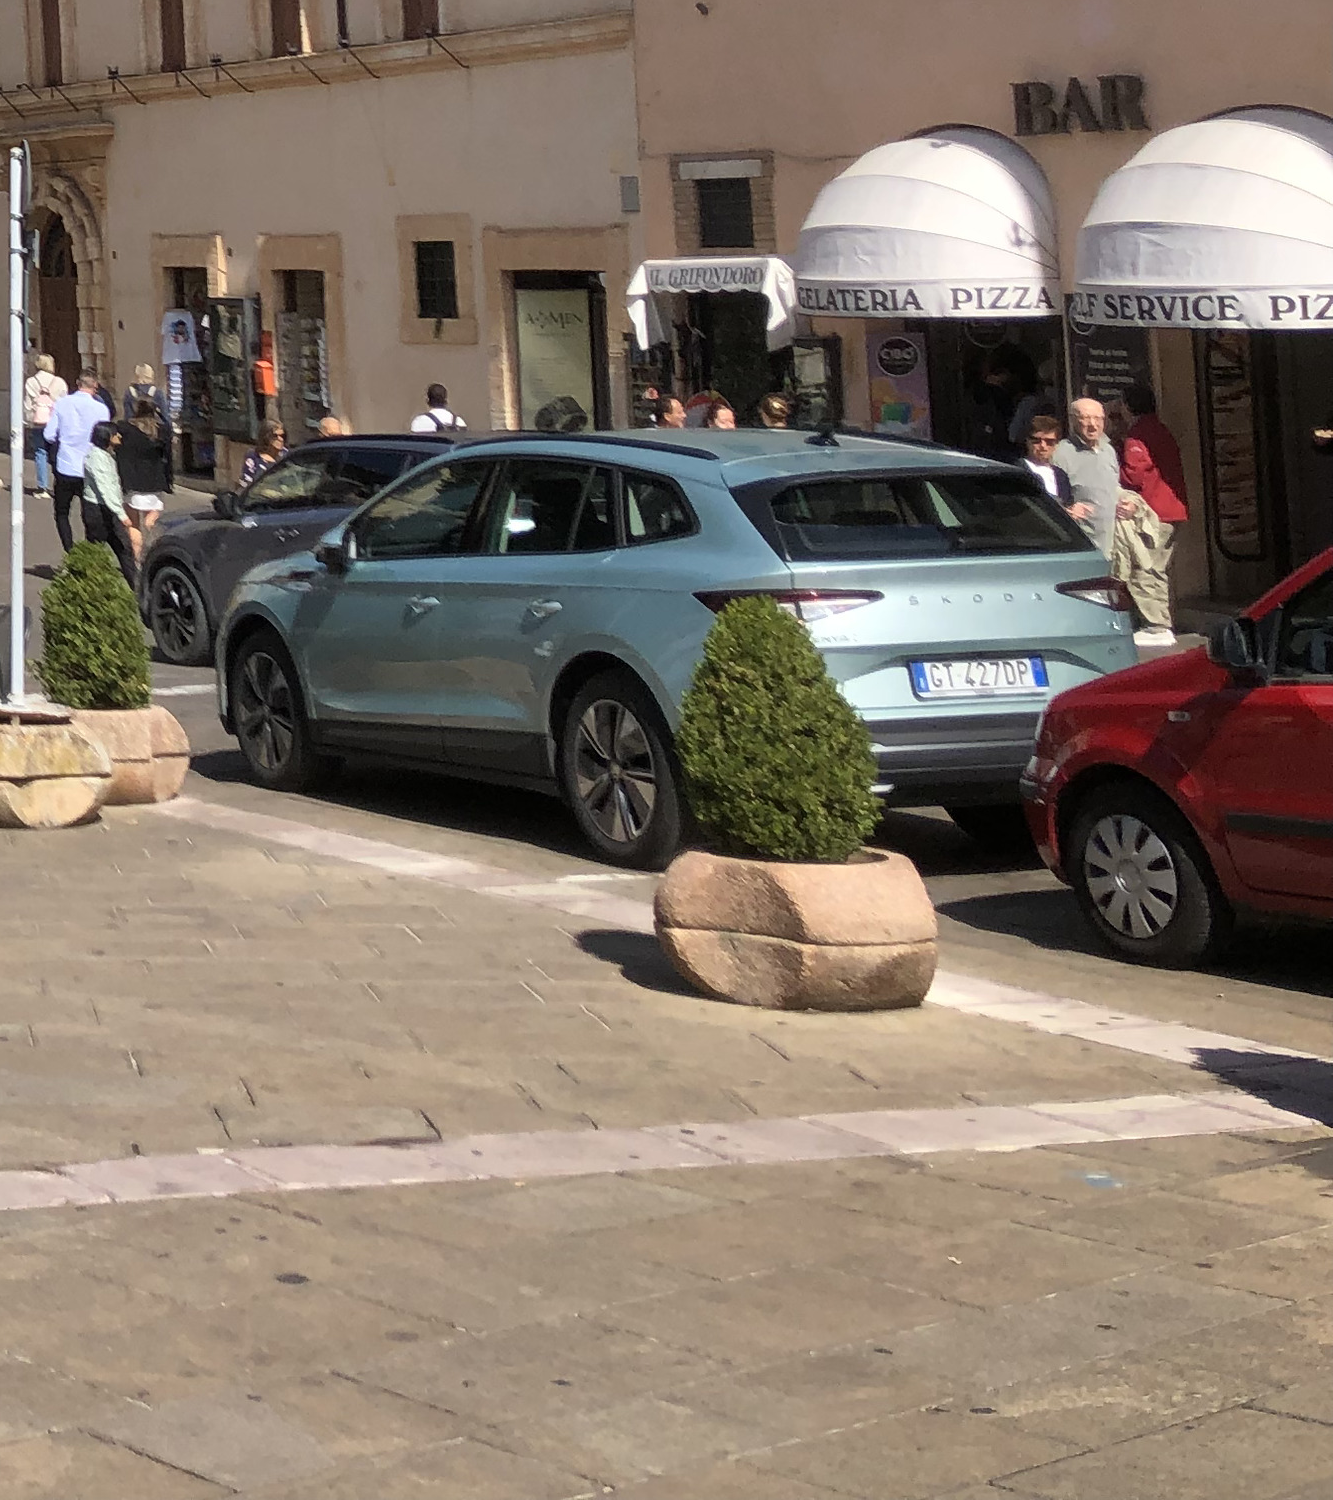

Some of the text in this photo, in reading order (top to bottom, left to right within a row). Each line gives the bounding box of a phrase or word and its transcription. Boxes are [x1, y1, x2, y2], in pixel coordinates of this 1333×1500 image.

[1009, 74, 1151, 136] BAR
[650, 266, 764, 288] IL GRIFONDORO
[797, 286, 1056, 312] GELATERIA PIZZA
[1103, 294, 1244, 322] SERVICE
[929, 663, 954, 688] GT
[964, 660, 1029, 687] 427DP
